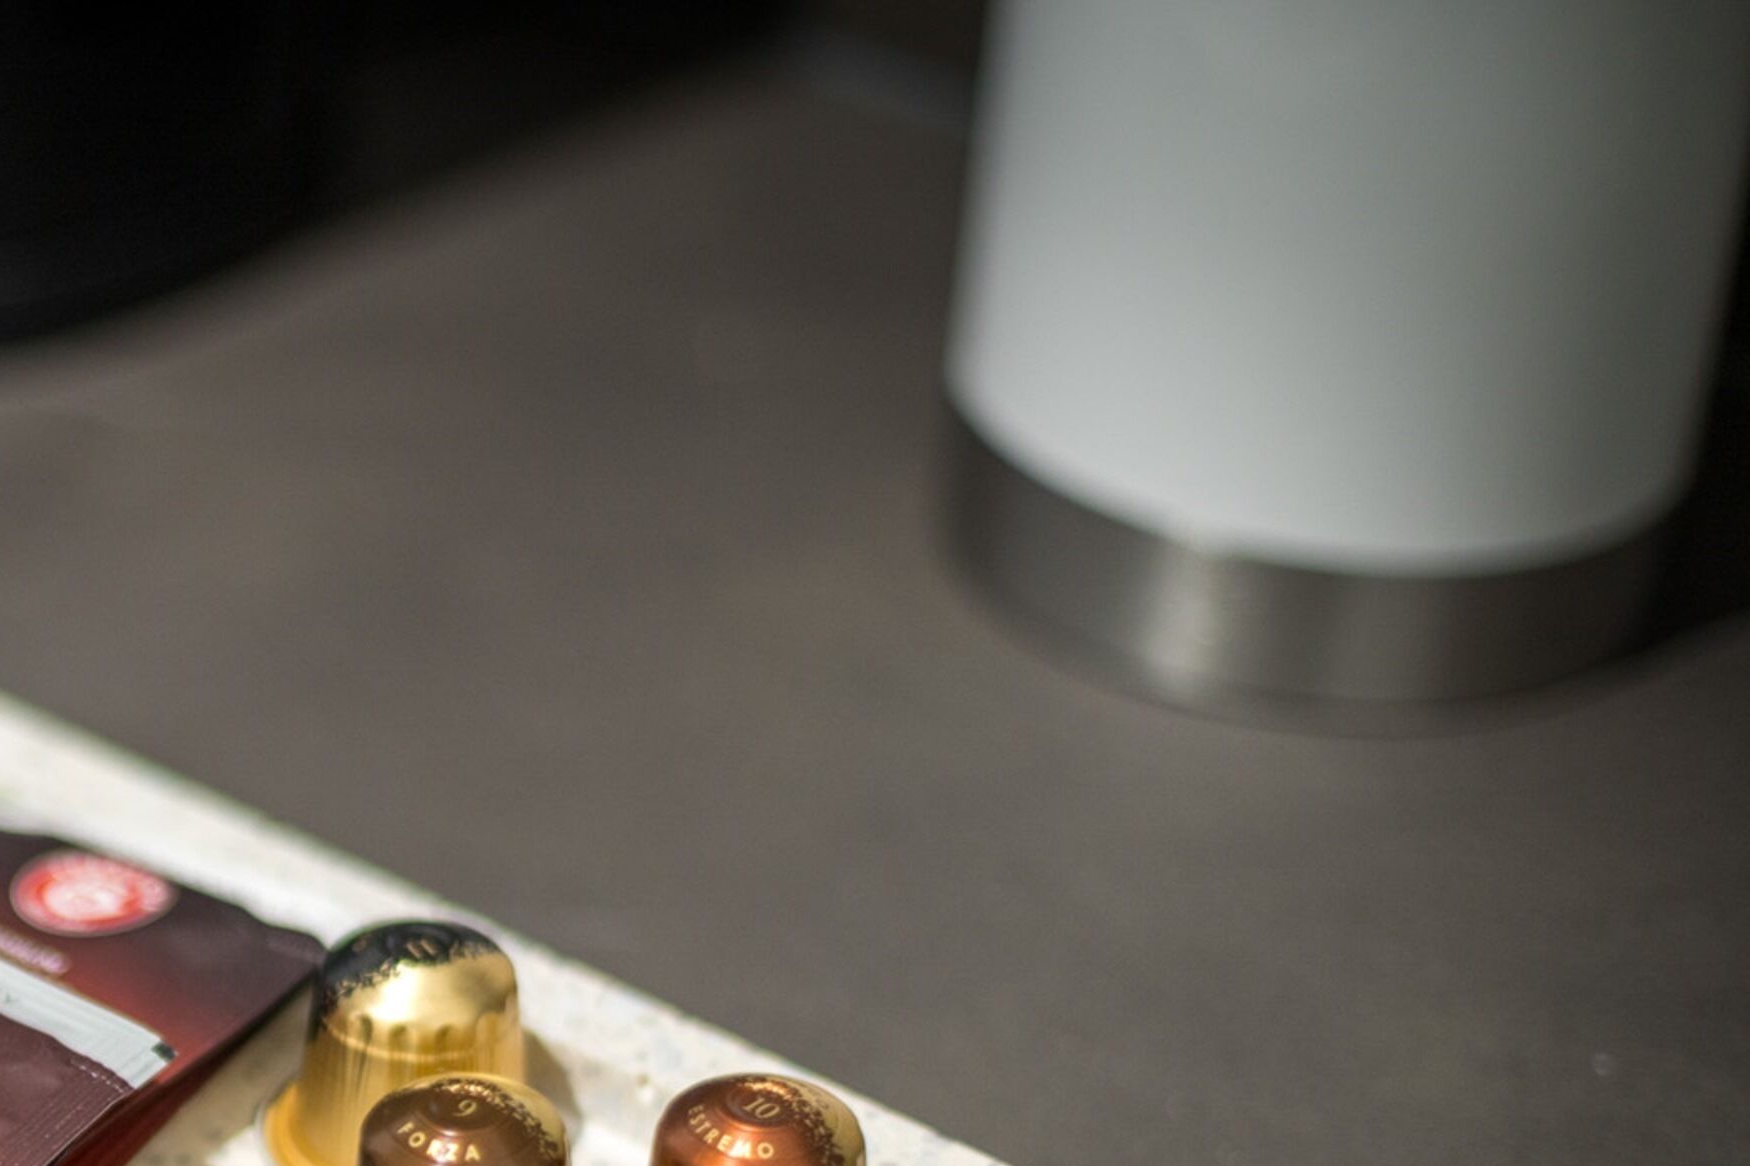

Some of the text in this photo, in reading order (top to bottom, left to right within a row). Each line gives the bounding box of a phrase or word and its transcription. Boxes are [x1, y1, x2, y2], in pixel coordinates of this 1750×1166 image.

[452, 1099, 478, 1118] 9
[743, 1098, 781, 1121] 10
[395, 1119, 482, 1164] FORZA
[687, 1104, 776, 1161] ESTREMO
